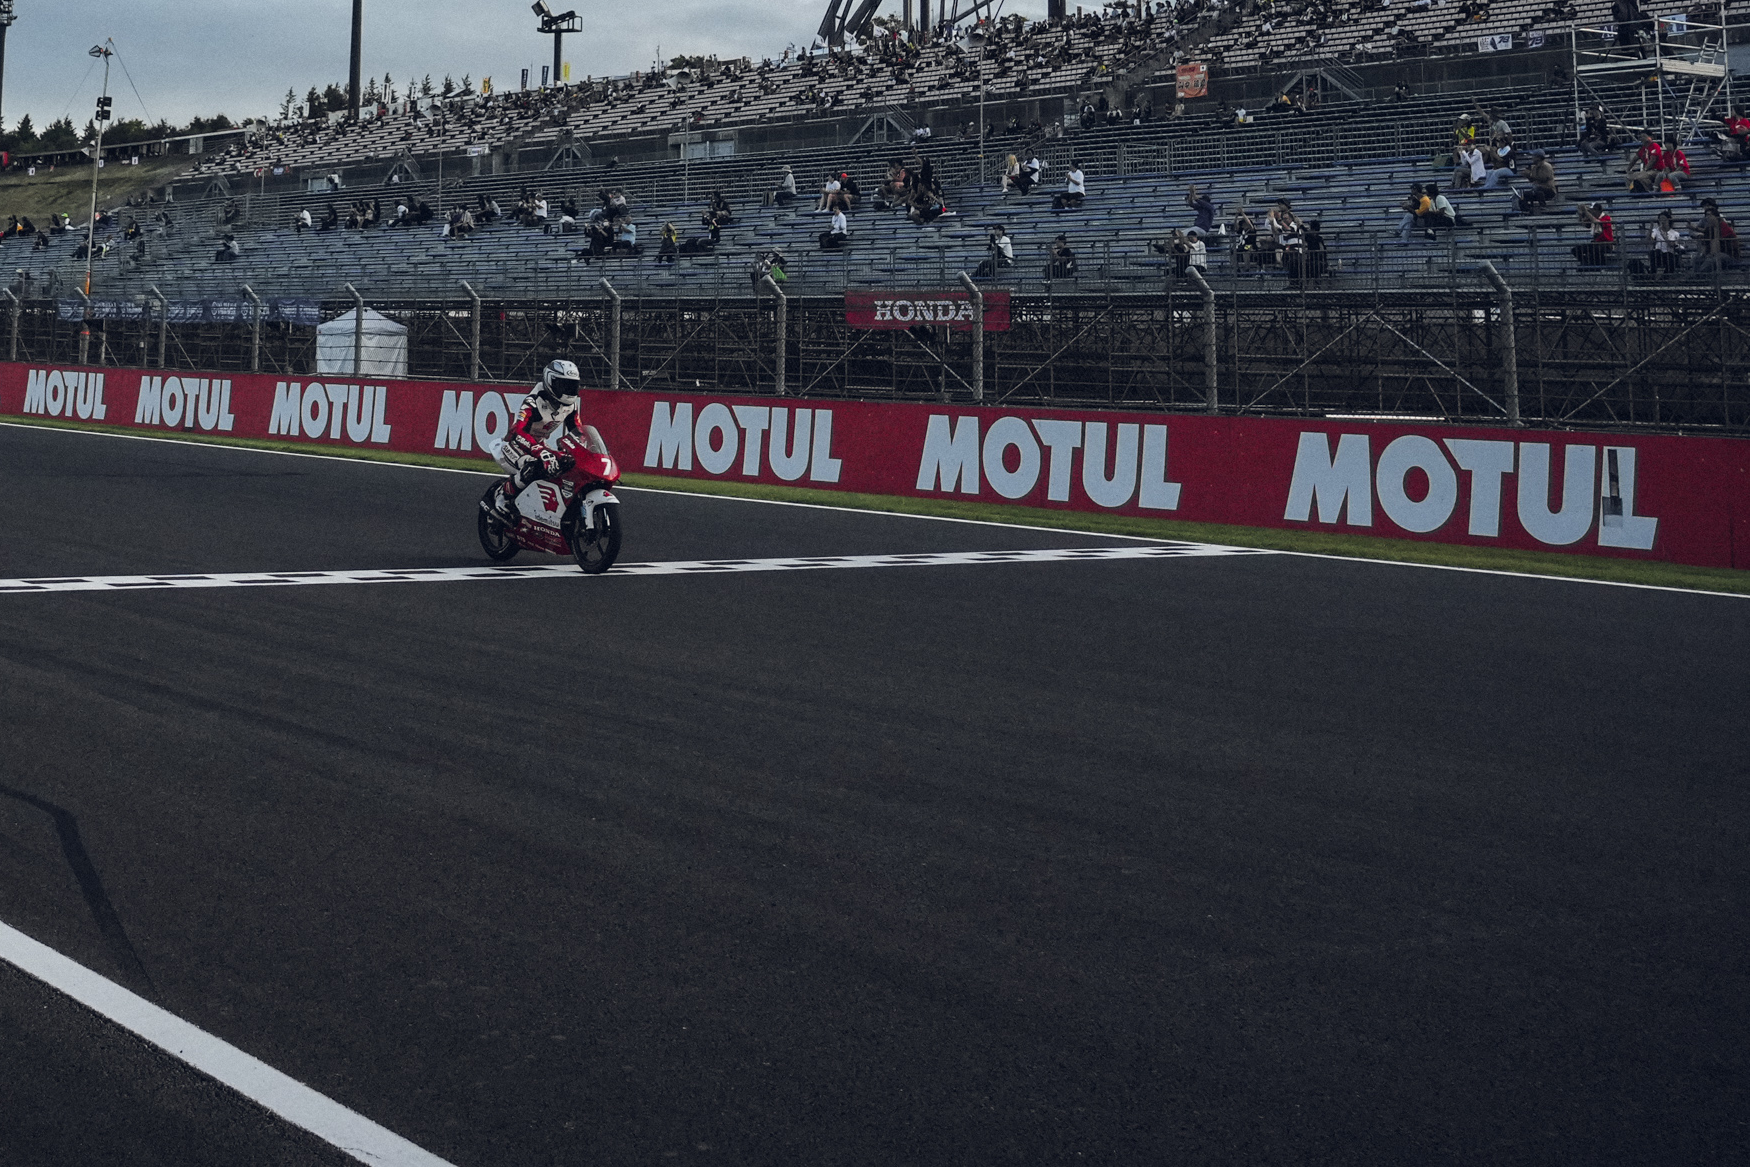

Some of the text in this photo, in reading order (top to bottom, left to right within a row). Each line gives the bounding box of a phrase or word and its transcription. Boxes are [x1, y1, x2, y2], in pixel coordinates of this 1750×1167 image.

[874, 300, 974, 321] HONDA
[23, 369, 107, 420] MOTUL
[134, 375, 235, 431] MOTUL
[268, 381, 392, 443] MOTUL
[601, 457, 612, 476] 7
[643, 401, 842, 483] MOTUL
[916, 414, 1182, 511] MOTUL
[1283, 431, 1658, 550] MOTUL
[533, 525, 560, 538] HONDA
